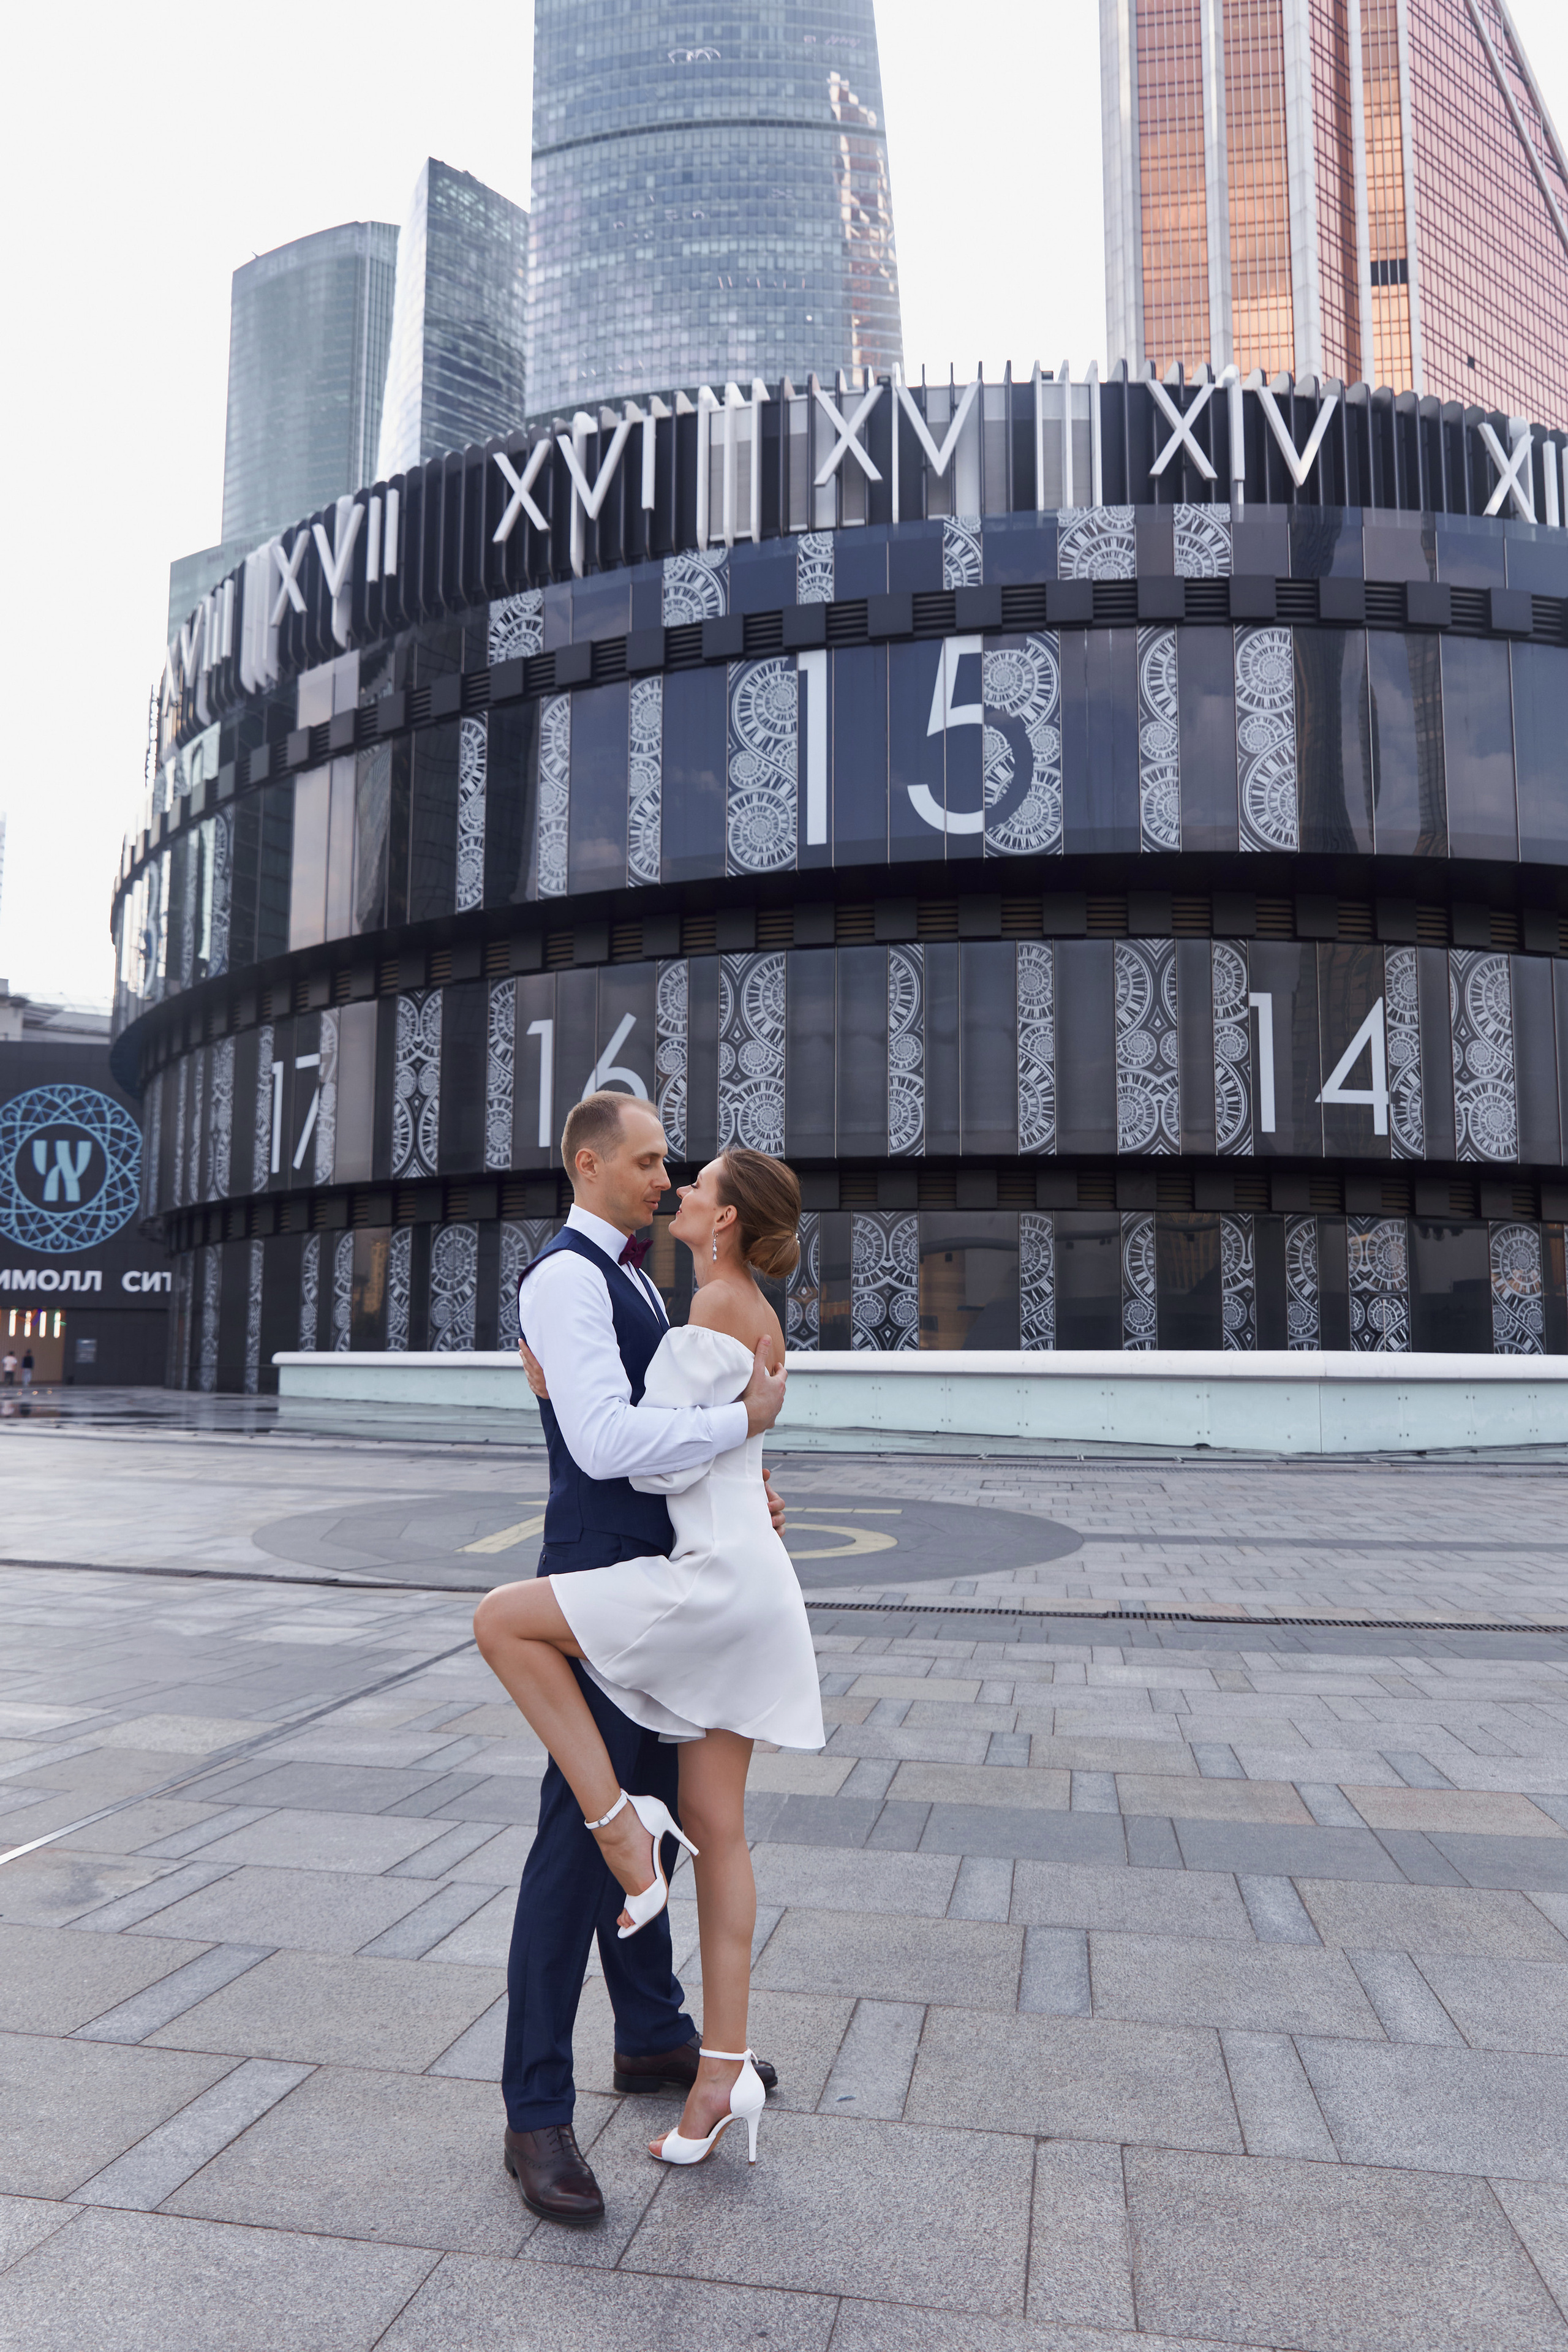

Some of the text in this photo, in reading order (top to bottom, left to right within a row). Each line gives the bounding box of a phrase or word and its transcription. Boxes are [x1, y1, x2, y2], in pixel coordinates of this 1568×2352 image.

[1146, 379, 1338, 487] XIV
[270, 488, 399, 627] XVII
[798, 635, 1035, 845] 15
[271, 1051, 334, 1174] 17
[526, 1012, 649, 1148] 16
[1249, 992, 1389, 1136] 14
